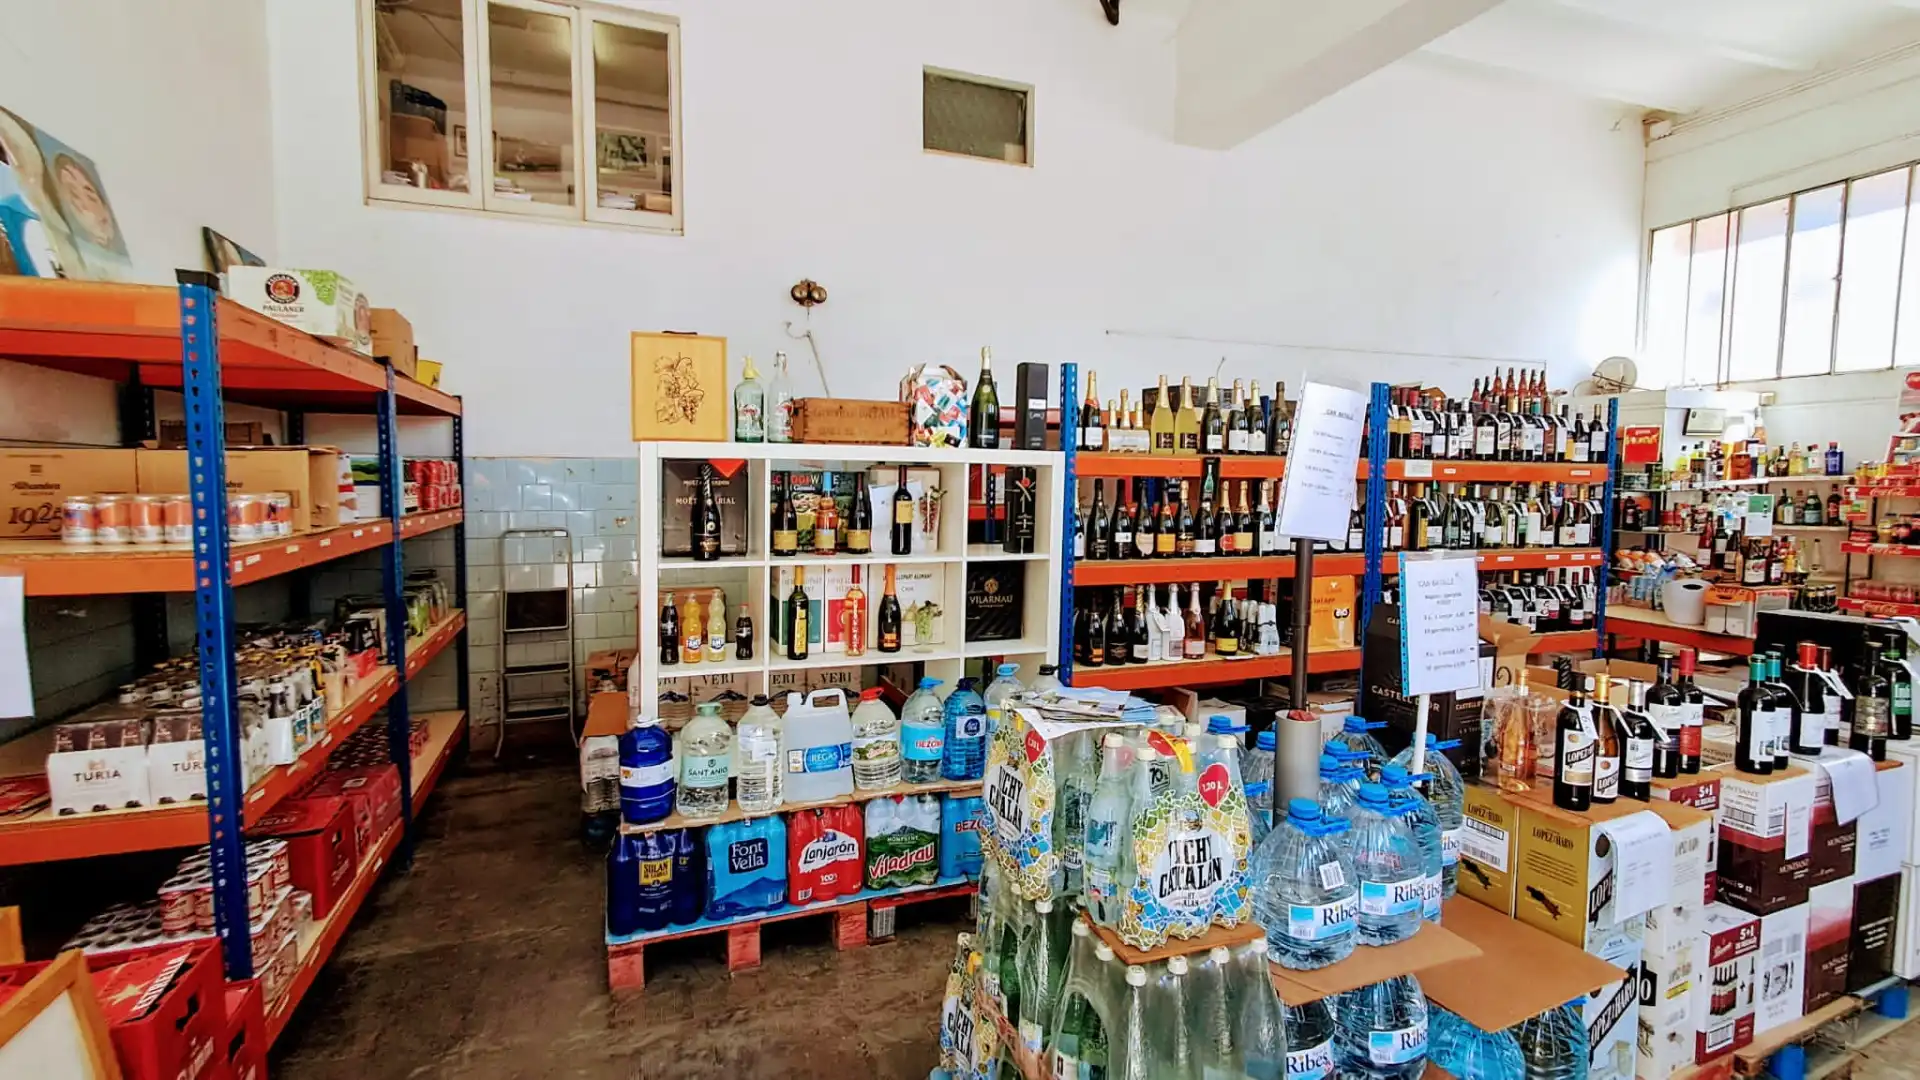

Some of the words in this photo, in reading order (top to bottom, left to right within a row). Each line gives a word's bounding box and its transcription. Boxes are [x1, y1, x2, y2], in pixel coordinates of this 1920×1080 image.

[262, 304, 304, 313] PAULANER
[12, 481, 61, 491] Alhambra
[8, 503, 62, 533] 1925
[969, 594, 1013, 605] VILARNAU
[702, 672, 735, 685] VERI
[770, 673, 796, 685] ERI
[820, 671, 852, 683] VERI
[811, 751, 839, 763] REGAS
[172, 760, 205, 773] TUR
[710, 766, 728, 775] ANIO
[73, 771, 122, 783] TURIA
[731, 841, 764, 856] Font
[803, 841, 856, 865] Lanjarón
[731, 854, 766, 871] Vella
[869, 843, 935, 880] Viladrau
[1739, 924, 1755, 941] 5+1
[131, 952, 191, 1012] ESTRELLA
[1590, 1017, 1611, 1047] OPEZ
[1400, 1030, 1428, 1050] Ribe
[1286, 1053, 1329, 1074] Ribes
